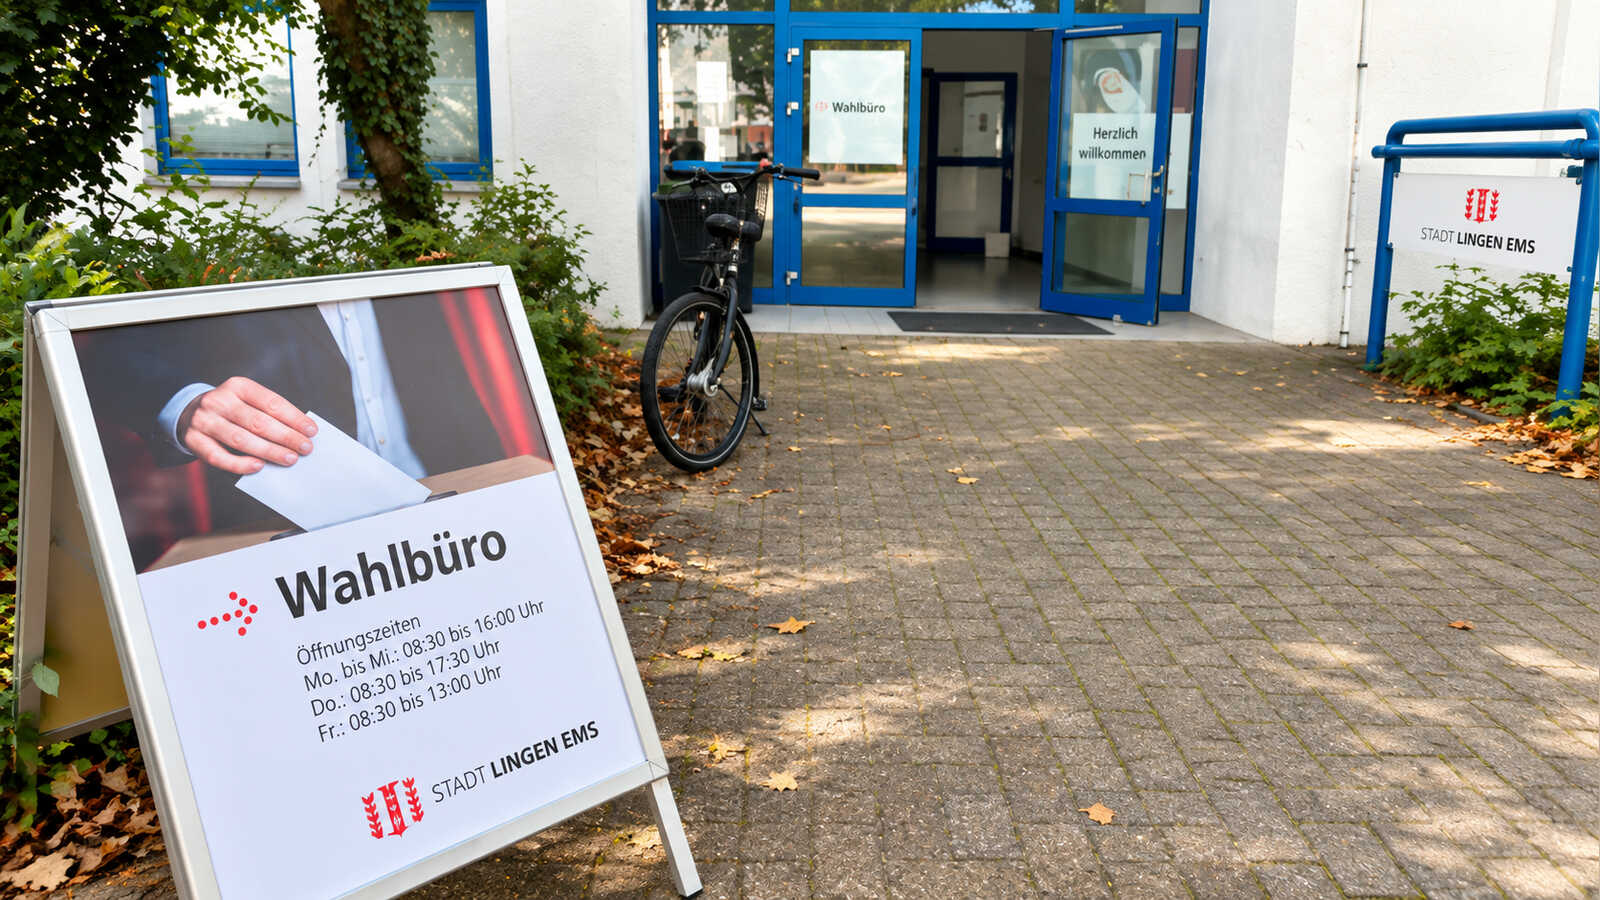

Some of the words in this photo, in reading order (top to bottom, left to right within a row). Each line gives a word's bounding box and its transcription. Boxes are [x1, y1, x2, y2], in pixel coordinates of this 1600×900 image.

[832, 101, 886, 113] Wahlbüro
[1093, 127, 1138, 140] Herzlich
[1079, 147, 1147, 160] willkommen
[1421, 227, 1455, 243] STADT
[1457, 231, 1503, 250] LINGEN
[1506, 237, 1536, 255] EMS
[275, 530, 507, 619] Wahlbüro
[296, 616, 421, 666] Öffnungszeiten
[303, 671, 338, 692] Mo.
[340, 658, 367, 680] bis
[368, 648, 400, 670] Mi.:
[402, 630, 446, 658] 08:30
[447, 624, 472, 643] bis
[474, 607, 516, 633] 16:00
[517, 600, 544, 619] Uhr
[310, 695, 347, 717] Do.:
[350, 673, 397, 704] 08:30
[399, 666, 424, 686] bis
[426, 647, 470, 676] 17:30
[472, 640, 500, 660] Uhr
[317, 722, 346, 743] Fr.:
[348, 700, 397, 731] 08:30
[398, 692, 424, 713] bis
[427, 673, 471, 702] 13:00
[473, 665, 501, 685] Uhr
[431, 765, 485, 803] STADT
[489, 736, 560, 779] LINGEN
[560, 720, 599, 750] EMS
